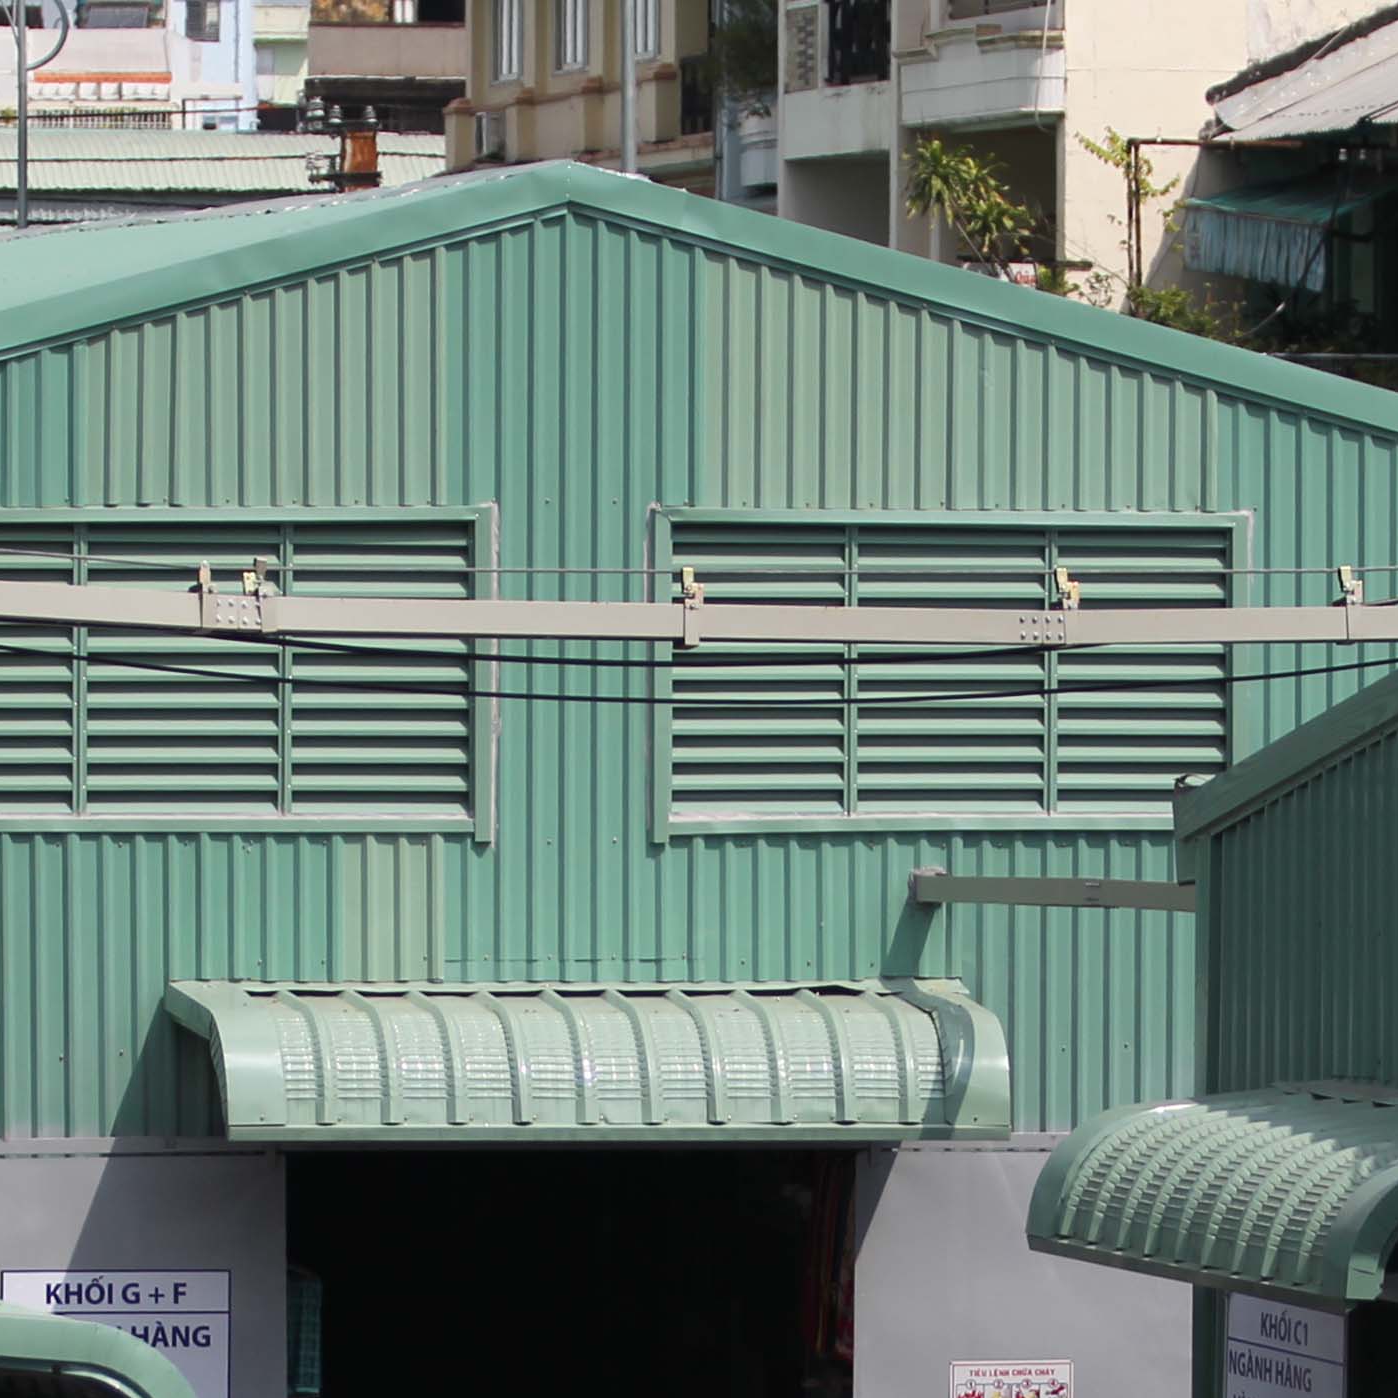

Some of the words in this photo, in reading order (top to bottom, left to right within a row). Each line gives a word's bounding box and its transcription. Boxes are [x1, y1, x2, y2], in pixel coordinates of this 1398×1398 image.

[45, 1276, 113, 1305] KHỐI
[121, 1282, 141, 1305] G
[148, 1286, 165, 1304] +
[173, 1283, 187, 1305] F
[1260, 1310, 1291, 1342] KHỐI
[1294, 1320, 1308, 1346] C1
[1229, 1348, 1272, 1384] NGÀNH
[1275, 1358, 1312, 1392] HÀNG
